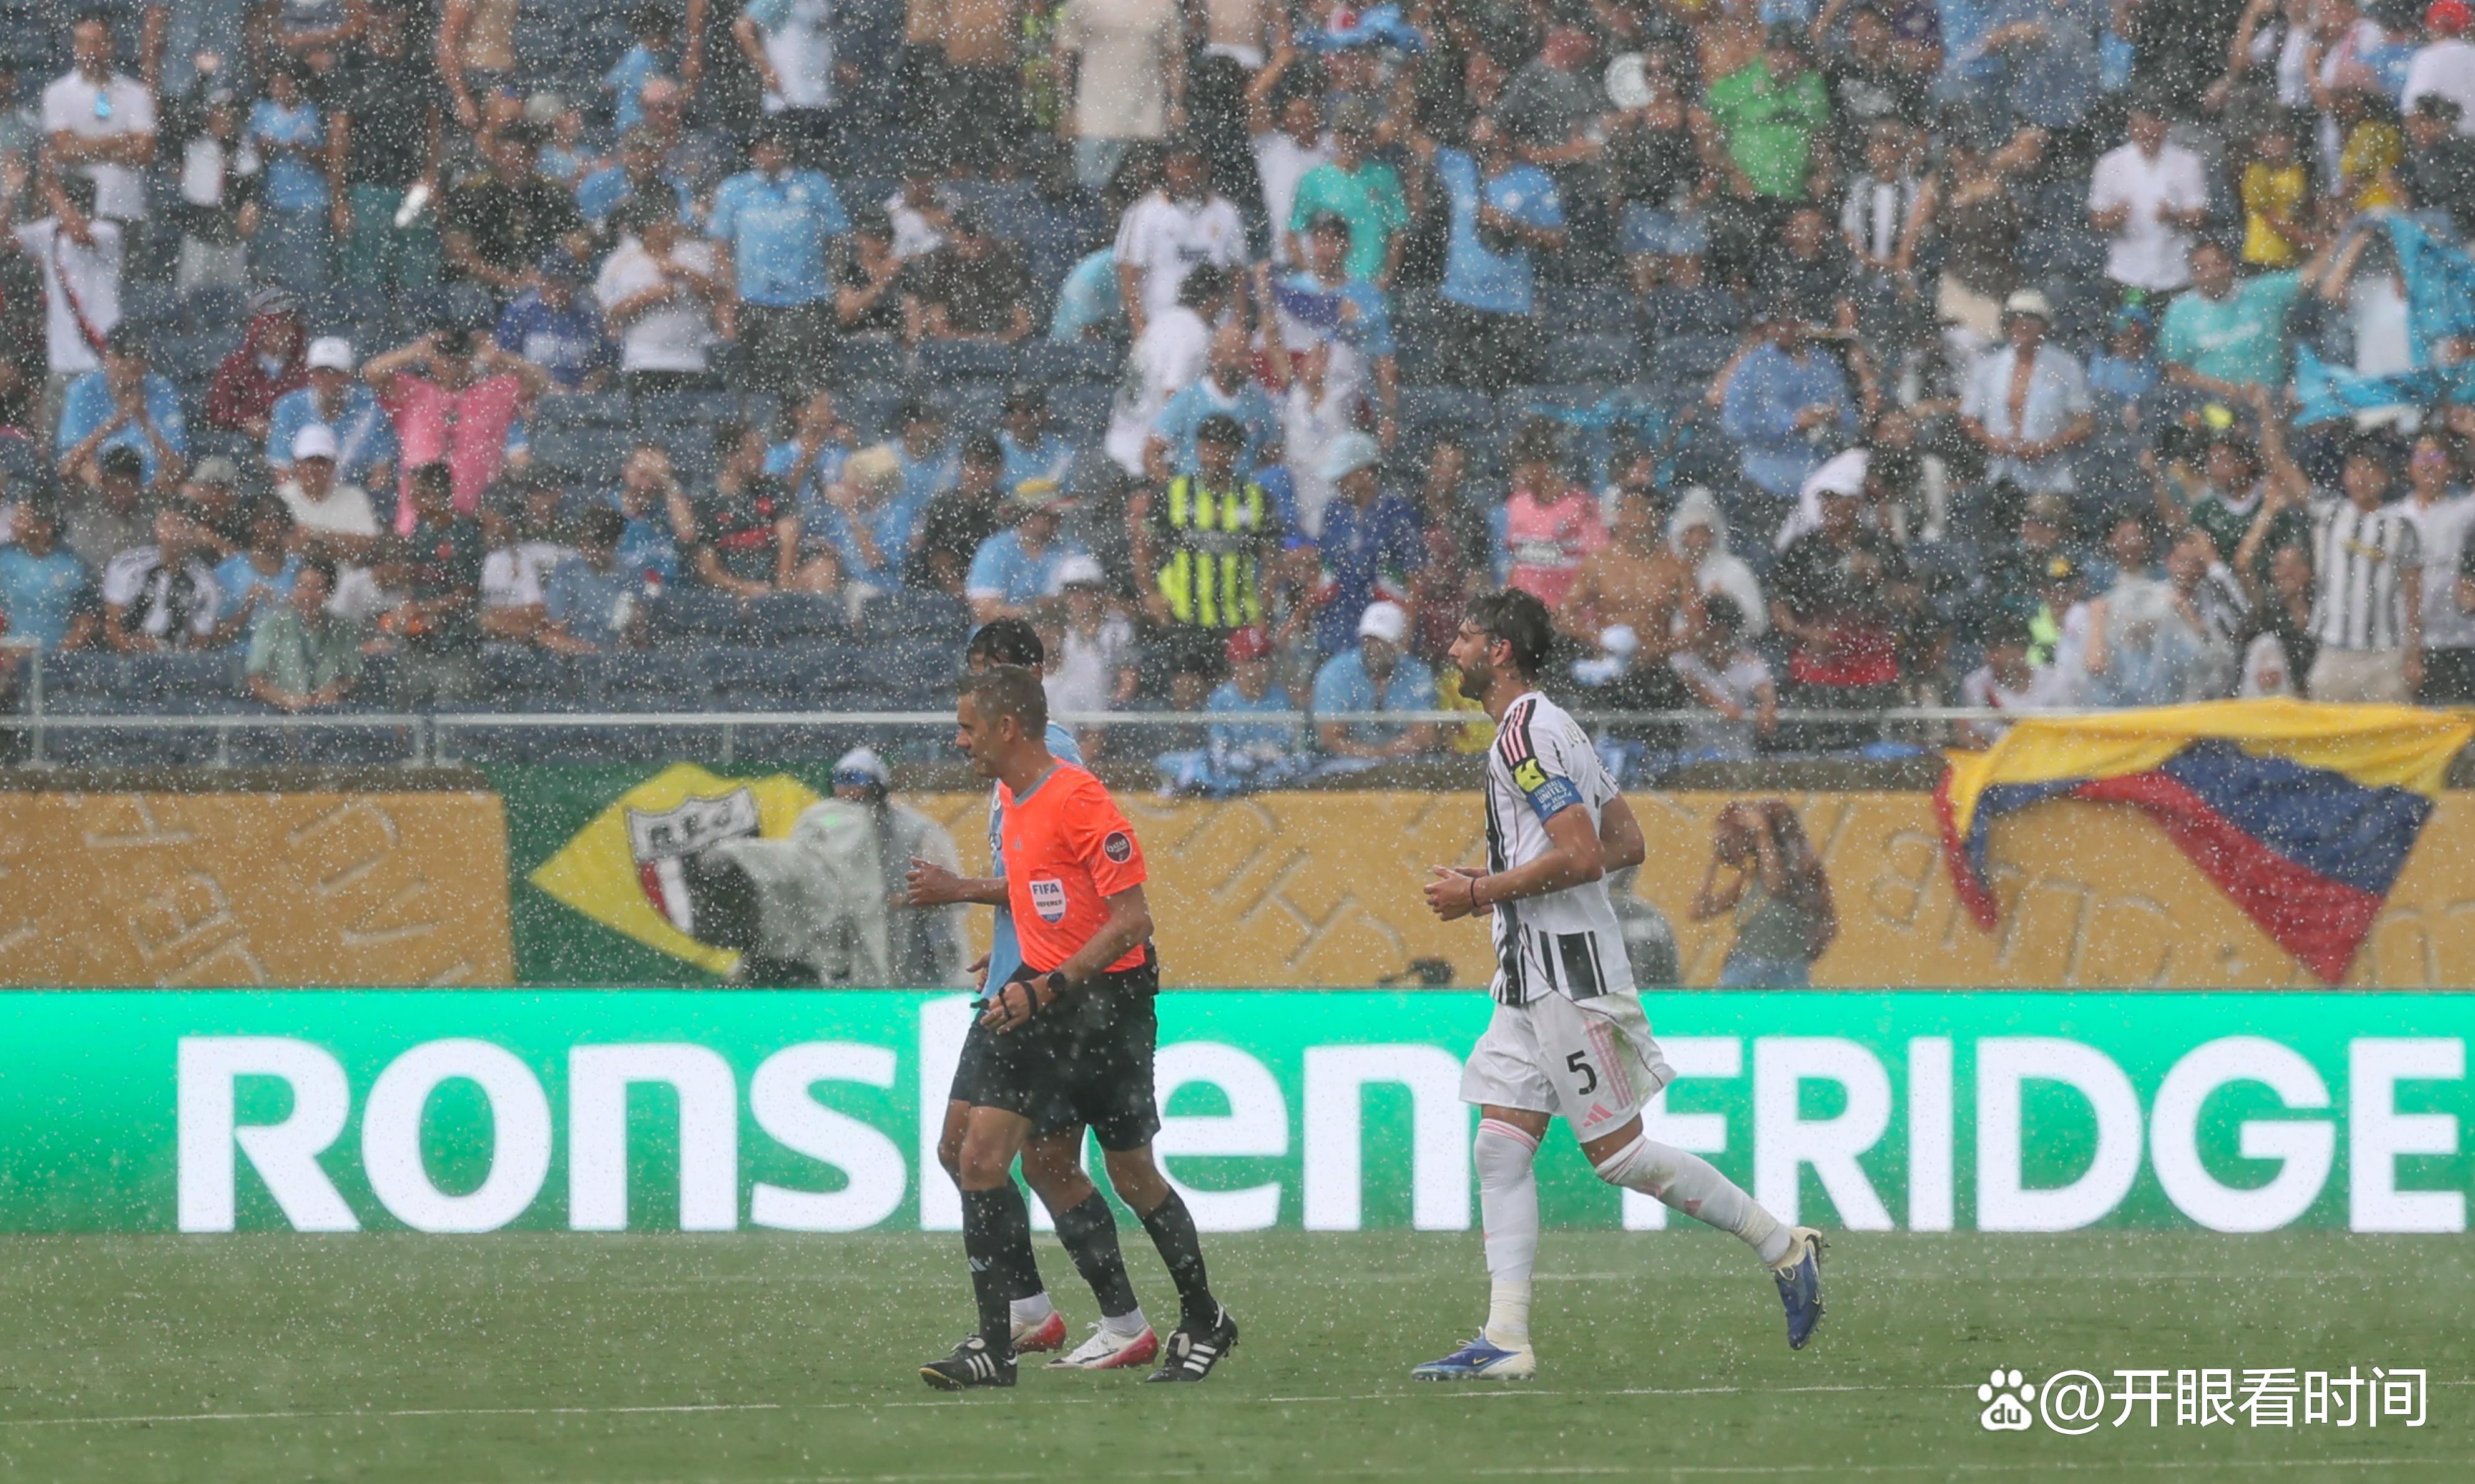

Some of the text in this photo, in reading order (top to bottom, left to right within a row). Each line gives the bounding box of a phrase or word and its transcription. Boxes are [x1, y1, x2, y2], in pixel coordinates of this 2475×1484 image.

[1537, 785, 1567, 804] UNITES
[1106, 839, 1127, 853] QATAR
[1032, 884, 1059, 895] FIFA
[1566, 1050, 1597, 1095] 5
[1623, 1036, 2467, 1233] FRIDGE
